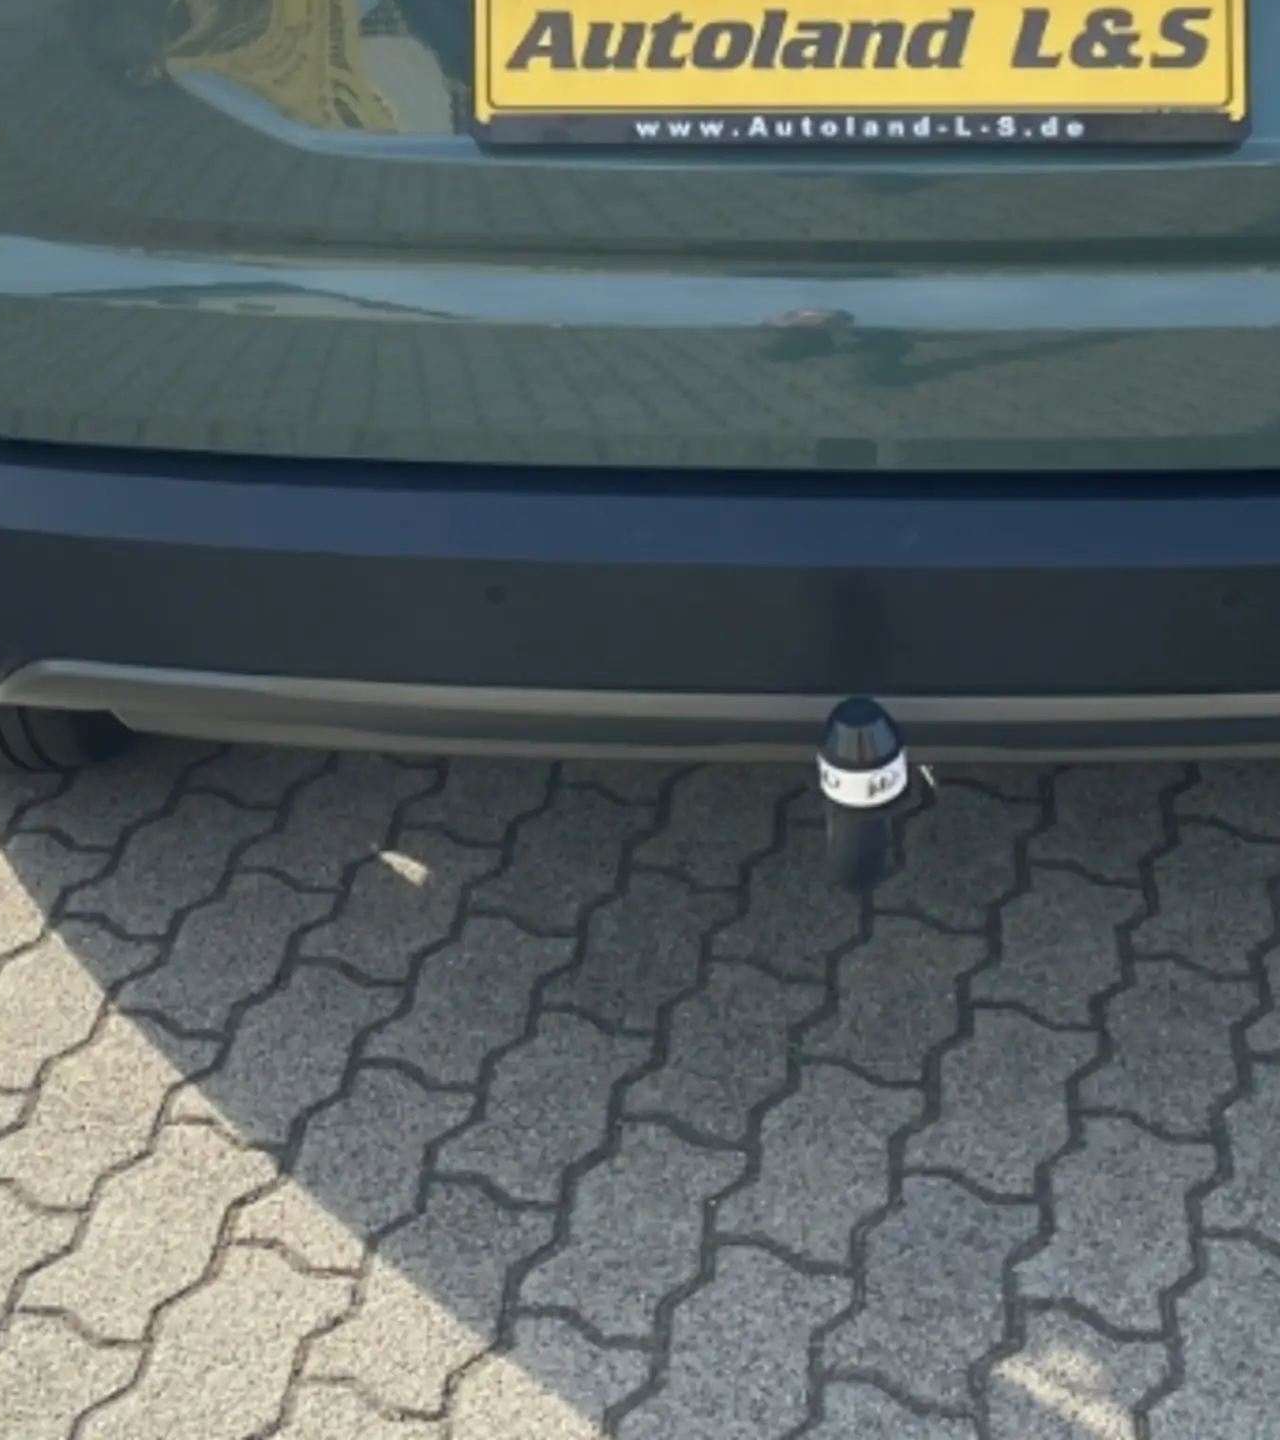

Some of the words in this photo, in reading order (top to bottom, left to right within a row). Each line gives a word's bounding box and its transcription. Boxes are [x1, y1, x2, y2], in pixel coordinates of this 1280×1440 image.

[505, 8, 975, 71] Autoland
[1011, 7, 1212, 69] L&S
[635, 110, 1084, 137] www.Autoland-L-S.de
